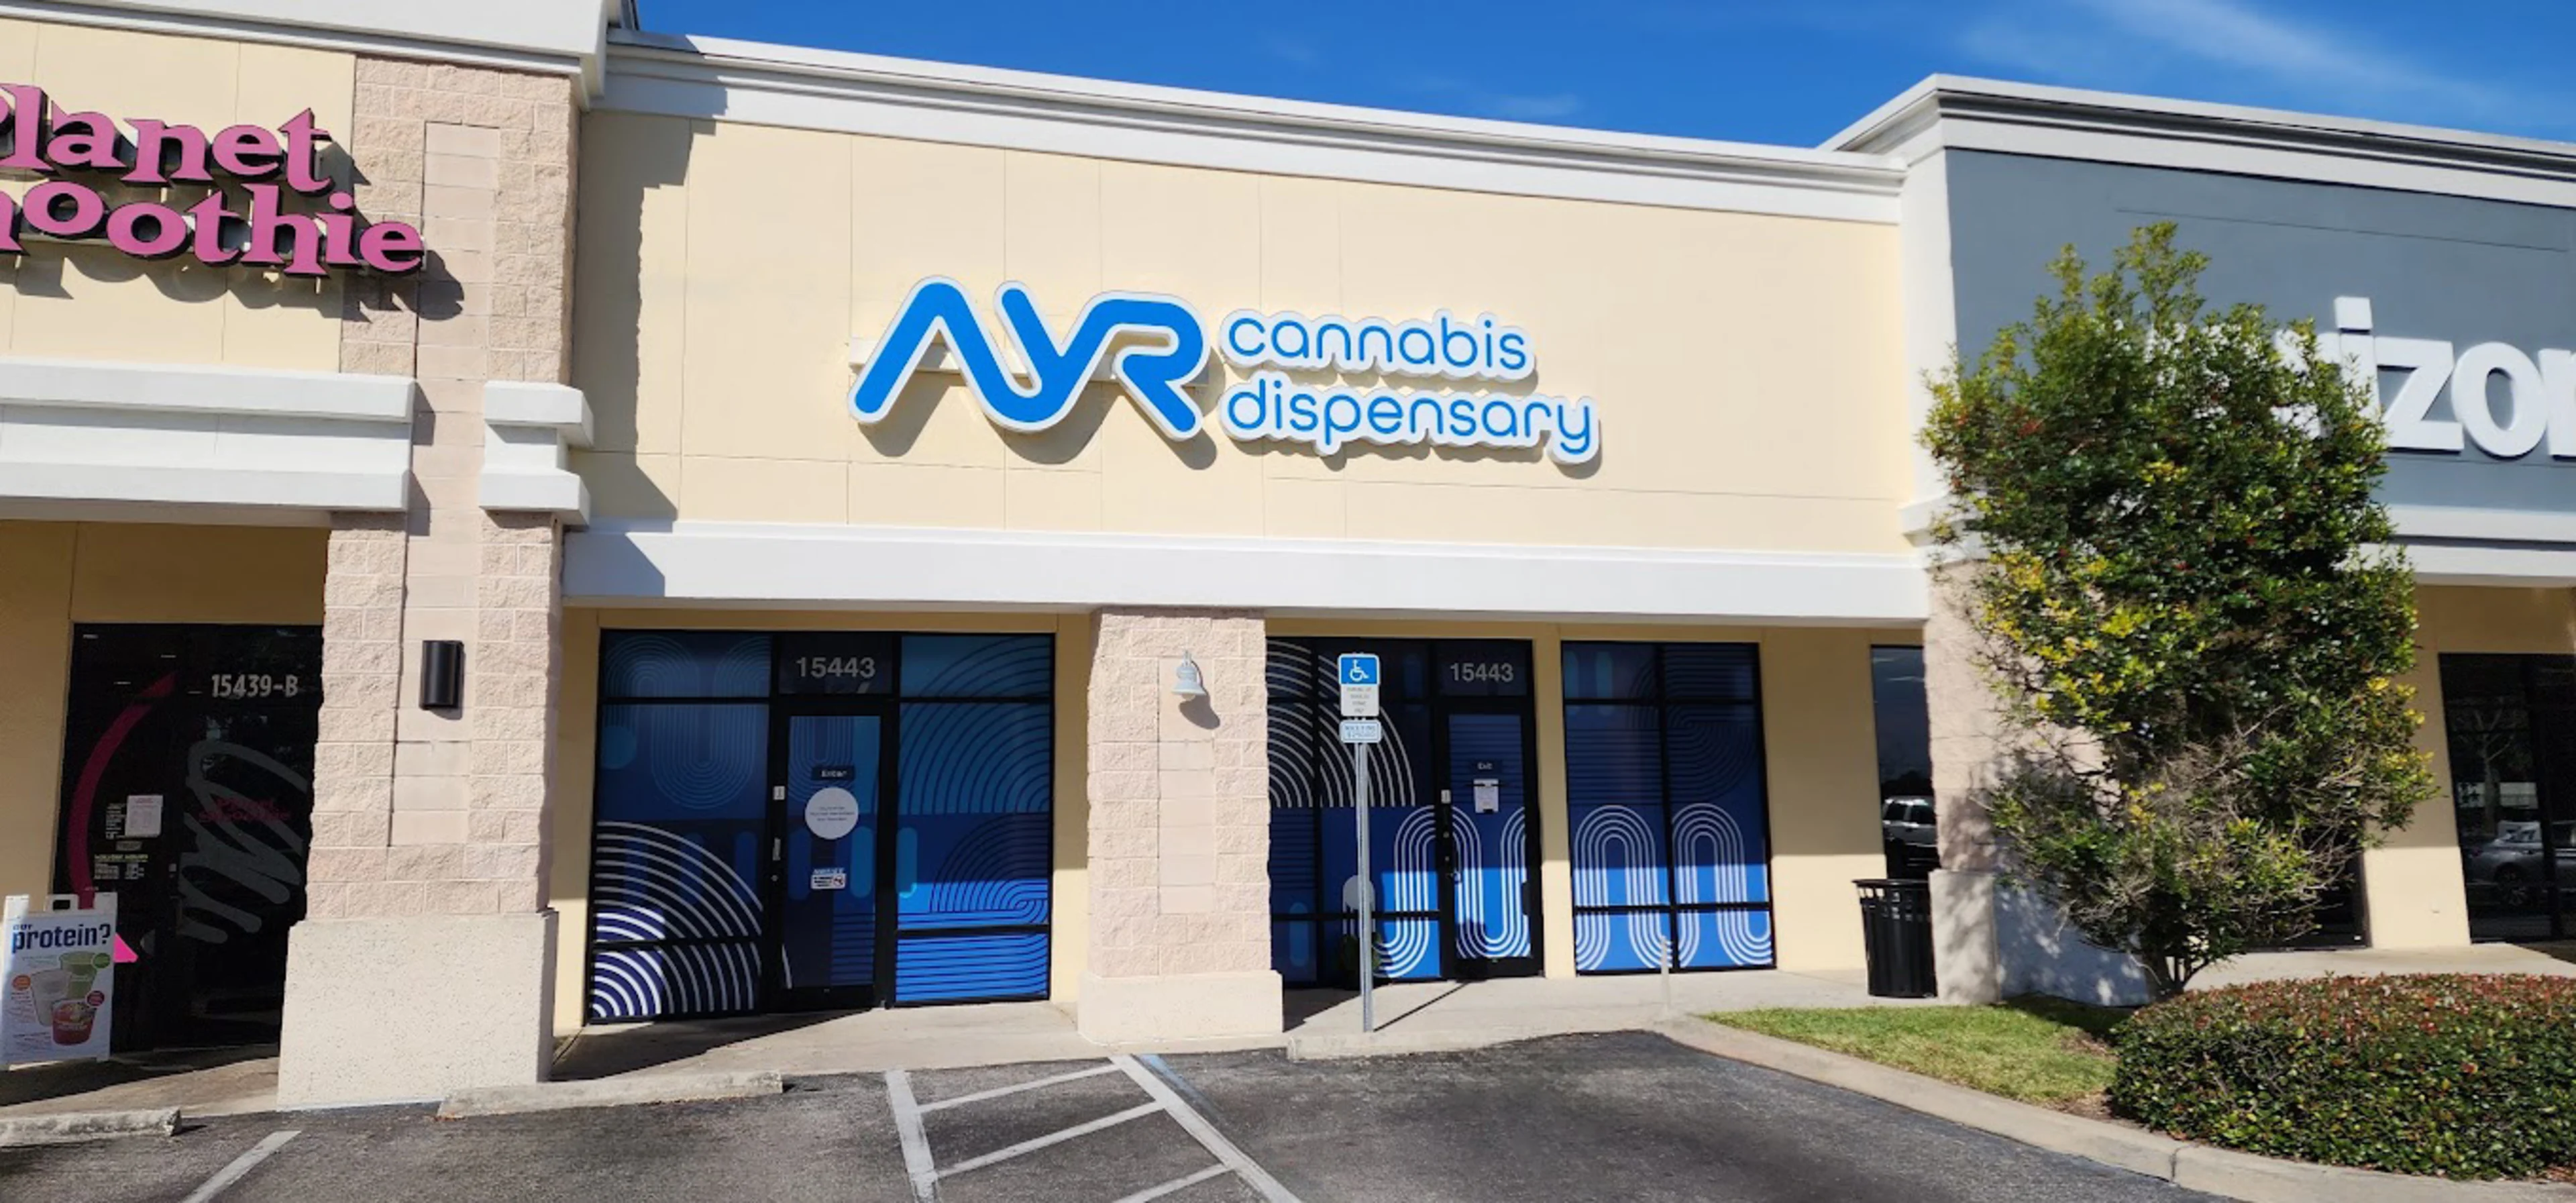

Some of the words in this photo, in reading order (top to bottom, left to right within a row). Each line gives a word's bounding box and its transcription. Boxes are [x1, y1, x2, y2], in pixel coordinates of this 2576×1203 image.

[0, 84, 333, 193] lanet
[0, 181, 425, 274] oothie
[853, 280, 1205, 434] AYR
[1228, 317, 1528, 371] cannabis
[1226, 378, 1593, 456] dispensary
[211, 674, 299, 698] 15439-B
[796, 657, 876, 678] 15443
[1450, 662, 1514, 682] 15443
[12, 923, 111, 953] protein?
